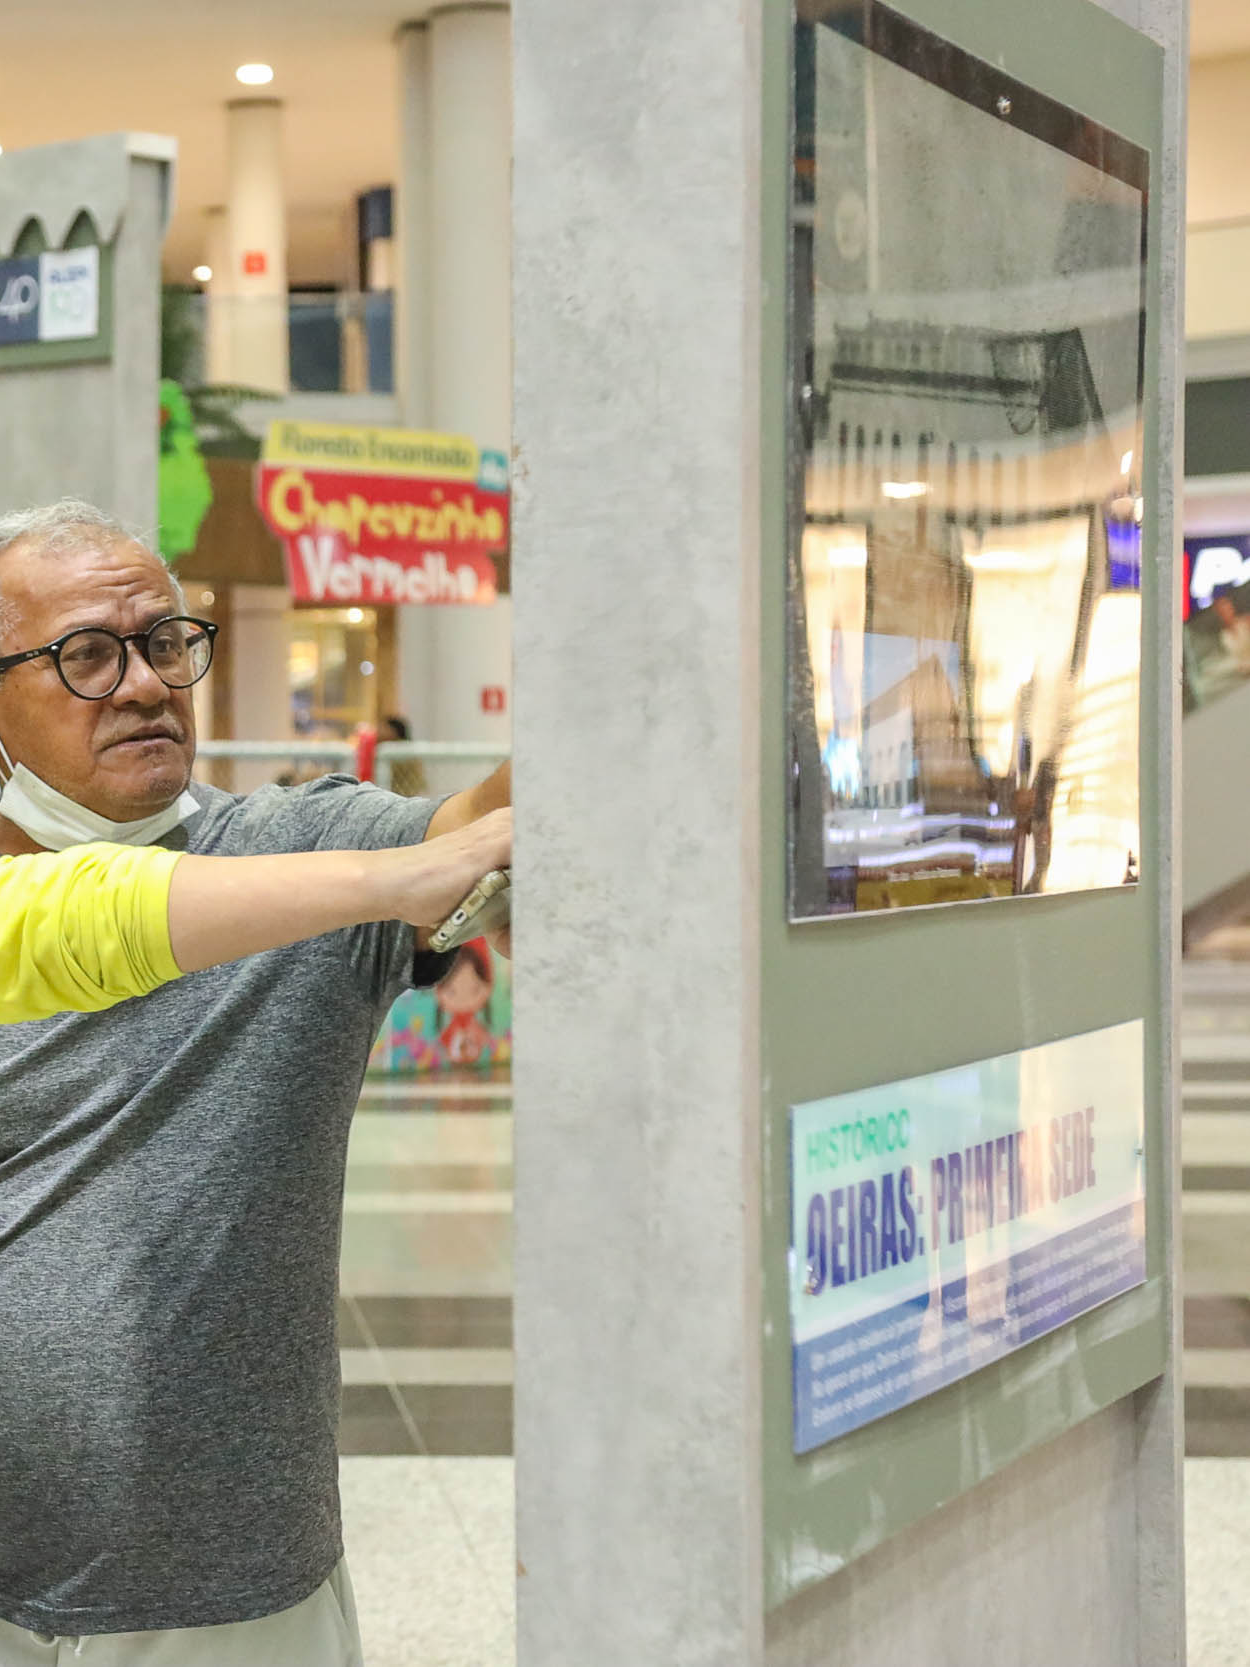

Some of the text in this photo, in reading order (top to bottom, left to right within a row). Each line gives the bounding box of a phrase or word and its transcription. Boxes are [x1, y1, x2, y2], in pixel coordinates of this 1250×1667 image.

[268, 467, 504, 546] Chapeuzinho
[298, 534, 479, 601] Vermelho
[806, 1106, 910, 1174] HISTÓRICO
[805, 1164, 925, 1296] OEIRAS:
[1049, 1105, 1096, 1204] SEDE
